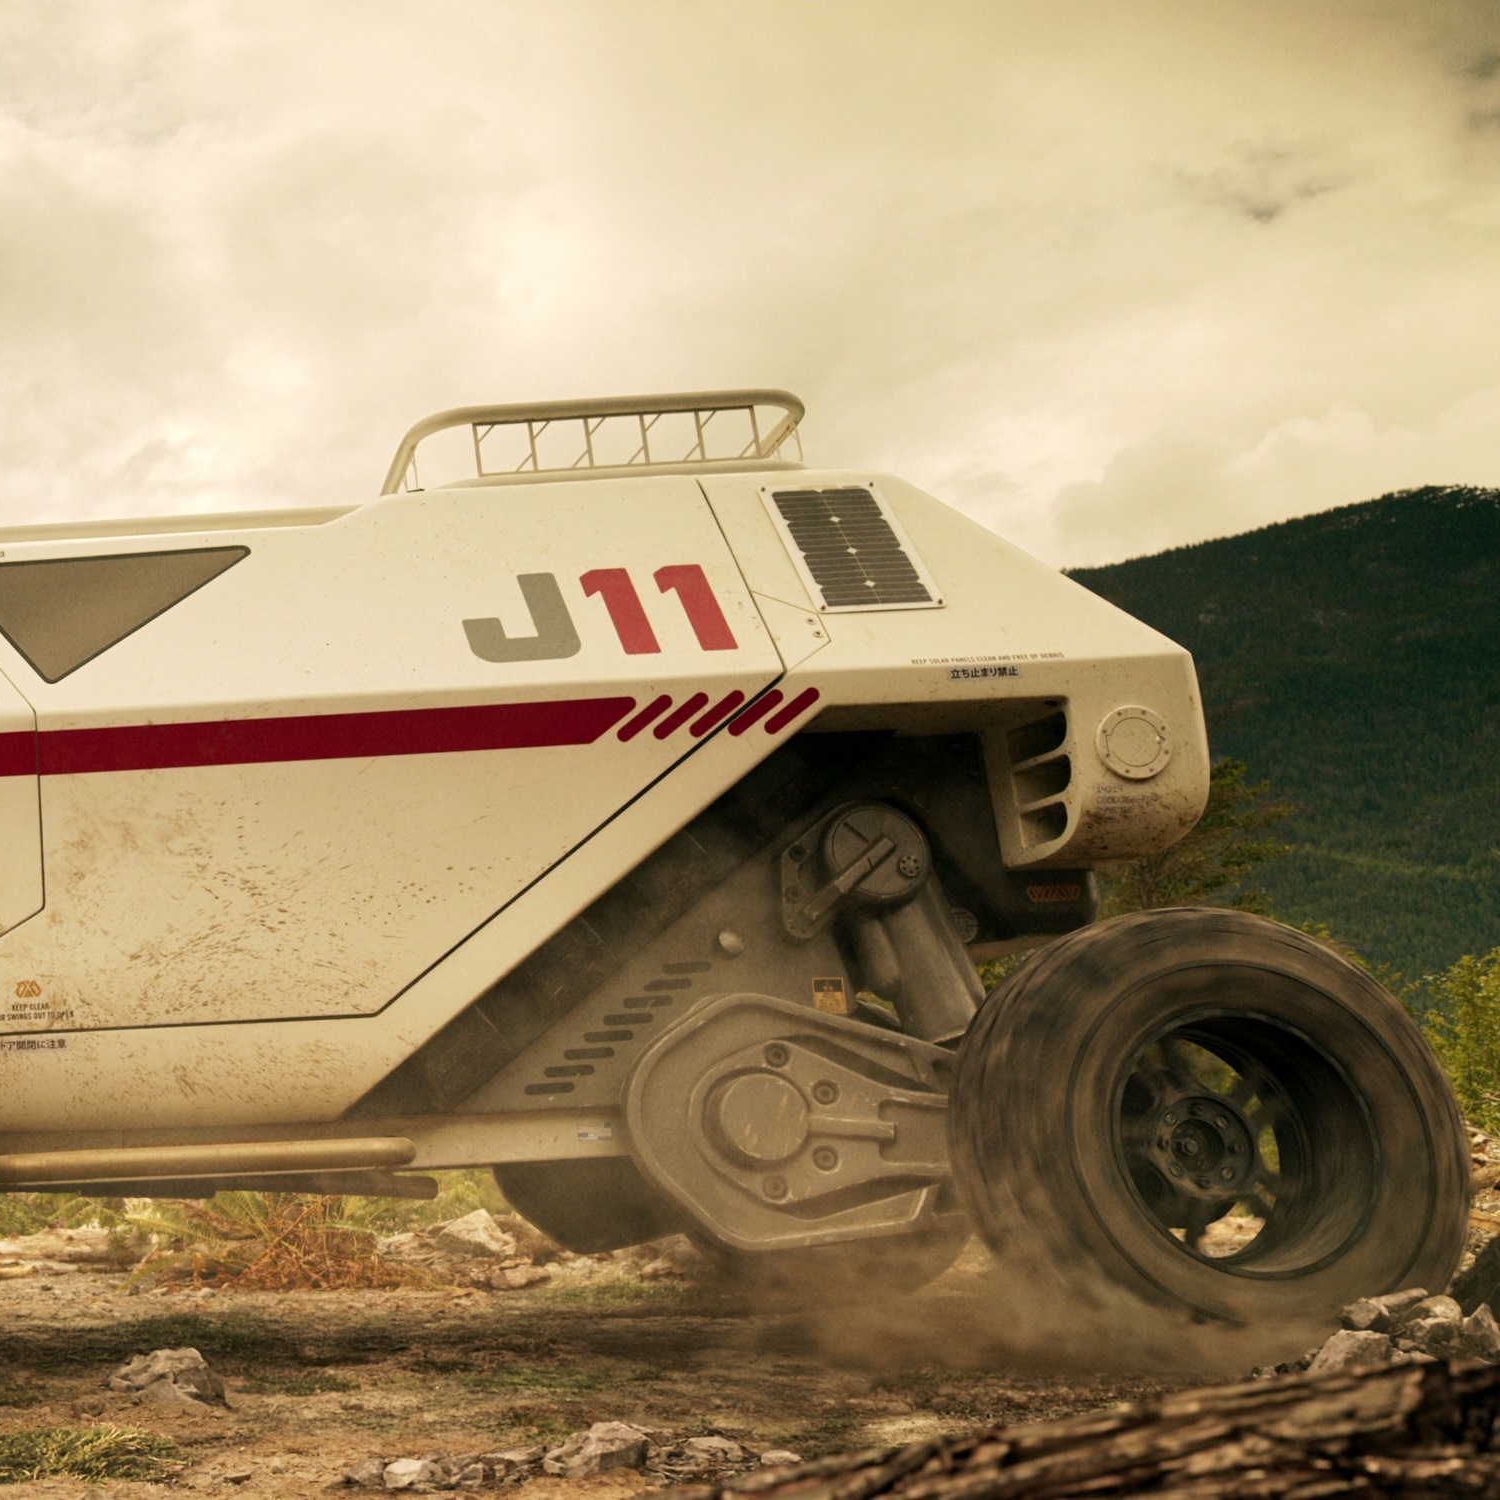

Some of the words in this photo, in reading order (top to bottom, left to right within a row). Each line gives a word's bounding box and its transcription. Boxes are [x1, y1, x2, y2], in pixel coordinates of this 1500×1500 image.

[462, 563, 739, 663] J11
[950, 666, 1019, 679] 立ち止まり禁止
[12, 1003, 28, 1011] KEEP
[29, 1002, 50, 1010] CLEAR
[8, 1012, 32, 1021] SWINGS
[34, 1011, 46, 1020] OUT
[47, 1011, 56, 1019] TO
[57, 1010, 74, 1019] OPEN
